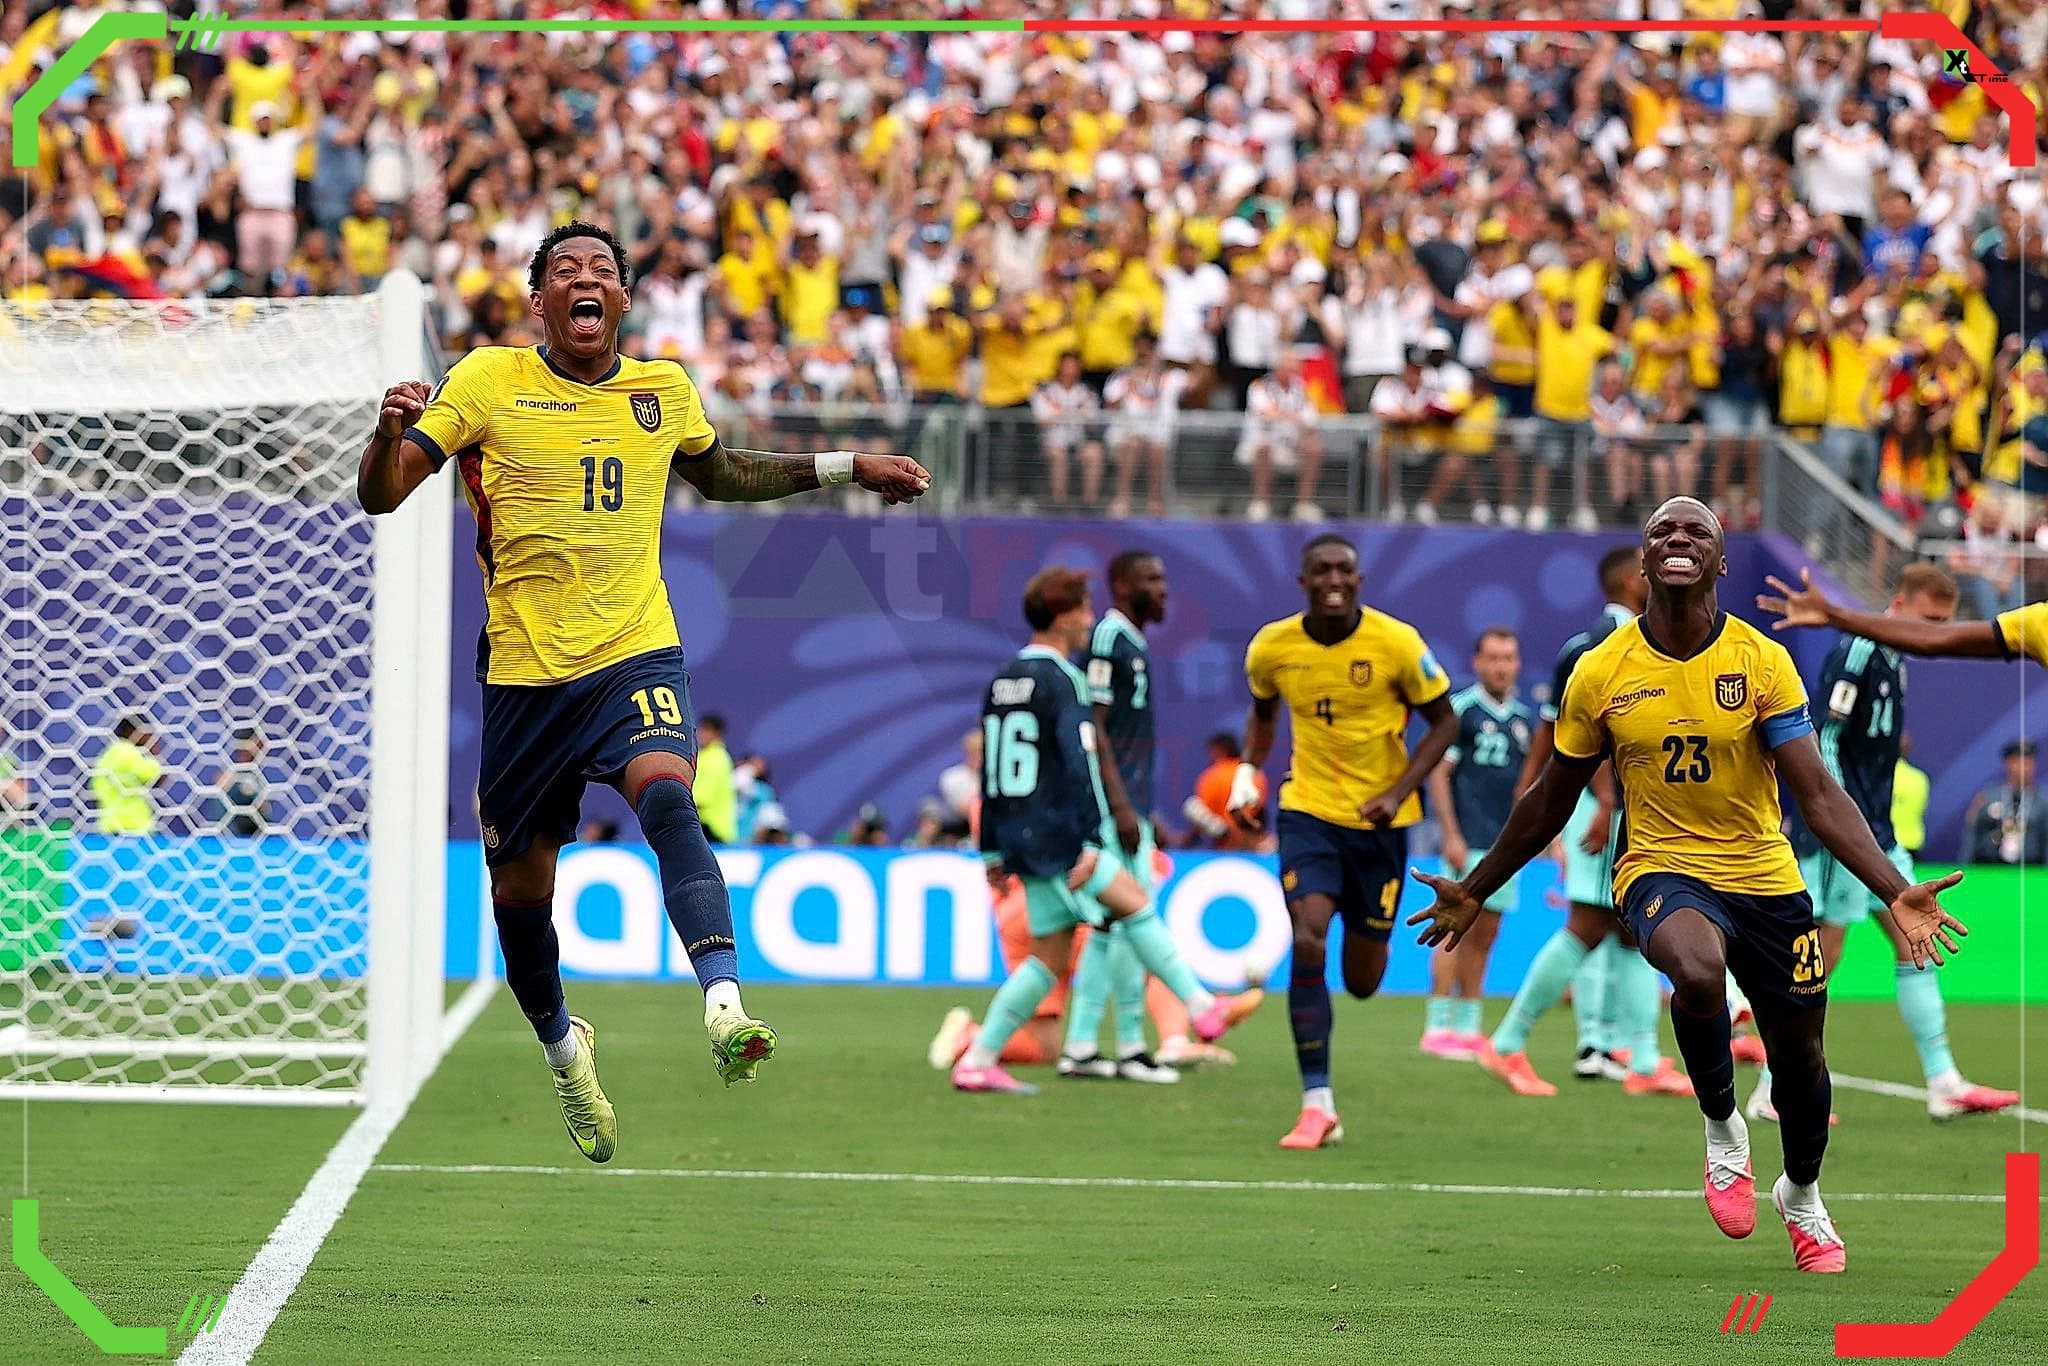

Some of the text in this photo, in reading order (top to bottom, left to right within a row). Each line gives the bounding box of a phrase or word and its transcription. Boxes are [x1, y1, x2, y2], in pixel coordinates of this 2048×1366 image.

[515, 399, 577, 412] marathon
[580, 456, 623, 512] 19
[631, 687, 683, 727] 19
[1317, 698, 1334, 726] 4
[1612, 688, 1665, 704] marathon
[630, 727, 686, 744] marathon
[983, 711, 1039, 798] 16
[1473, 731, 1509, 767] 22
[1662, 735, 1711, 783] 23
[1793, 928, 1824, 982] 23
